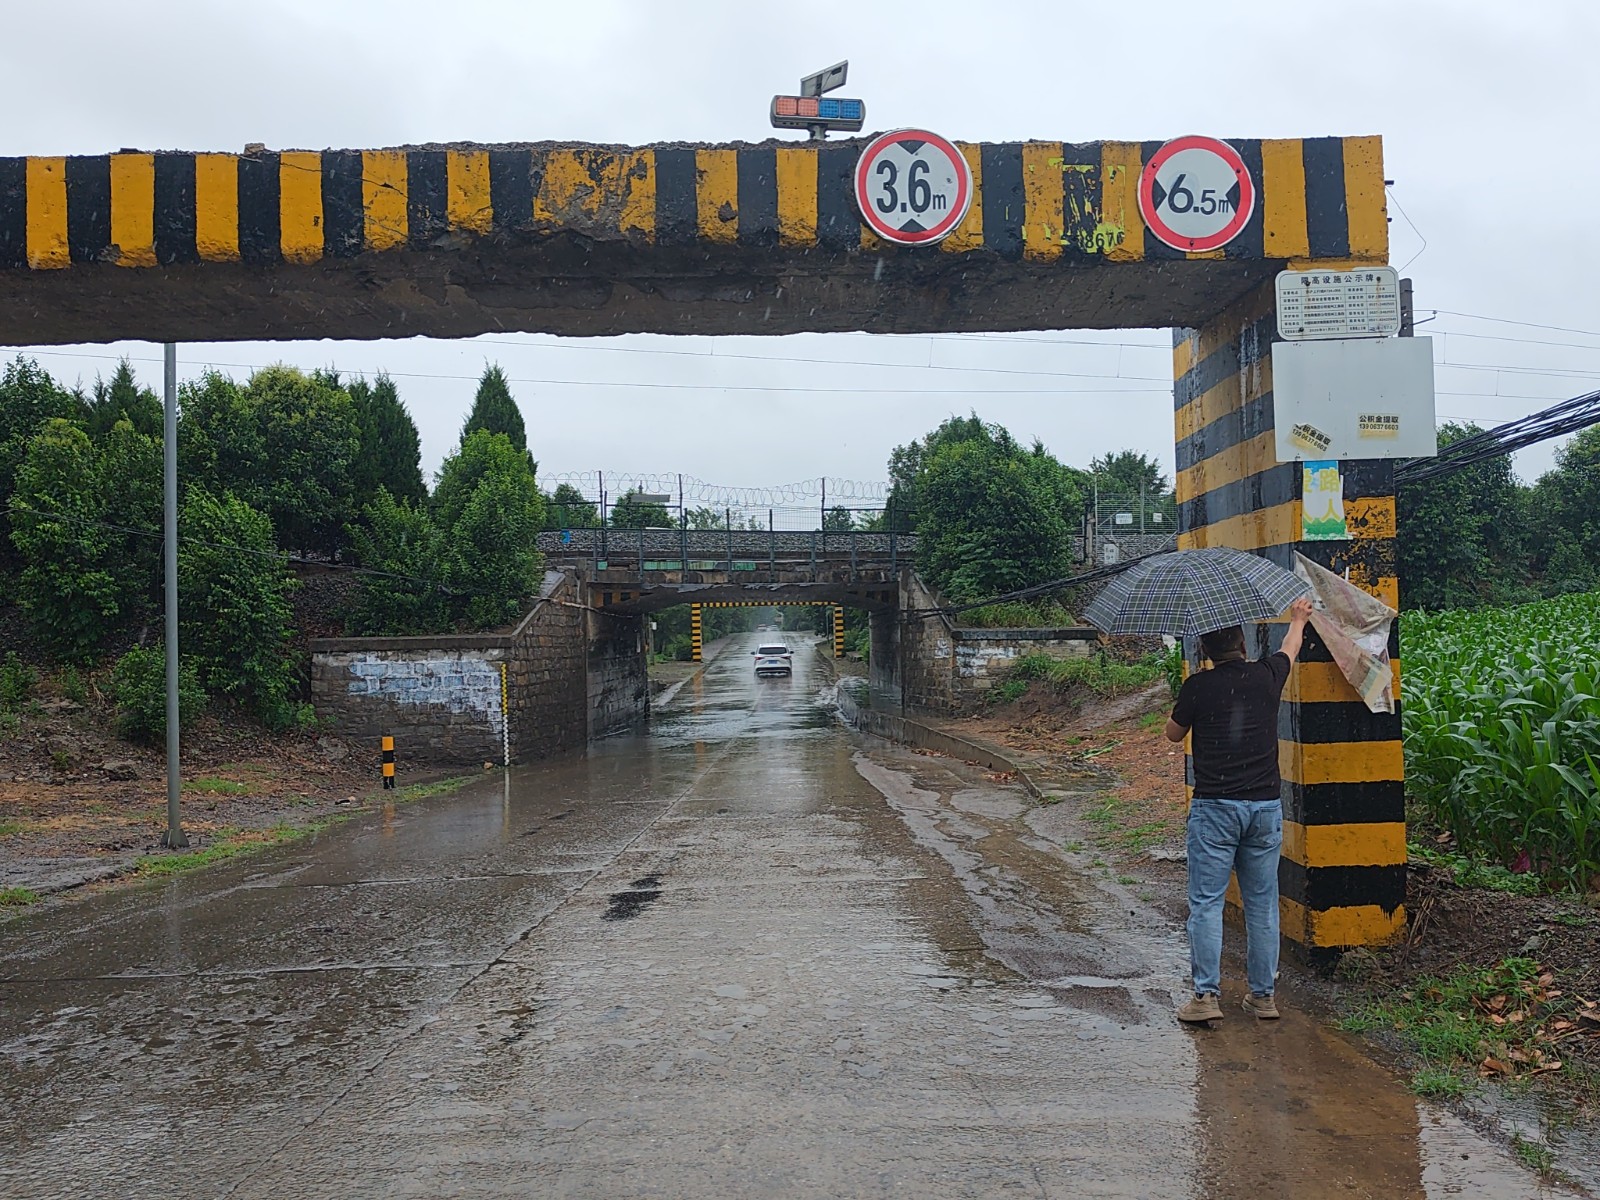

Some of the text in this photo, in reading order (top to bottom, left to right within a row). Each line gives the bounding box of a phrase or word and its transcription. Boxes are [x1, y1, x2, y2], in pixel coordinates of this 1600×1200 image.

[876, 159, 947, 214] 3.6m
[1167, 173, 1229, 215] 6.5m
[1301, 273, 1374, 285] 限高设施公示牌
[1359, 415, 1399, 423] 公积金提取
[1295, 423, 1332, 446] 积金提取
